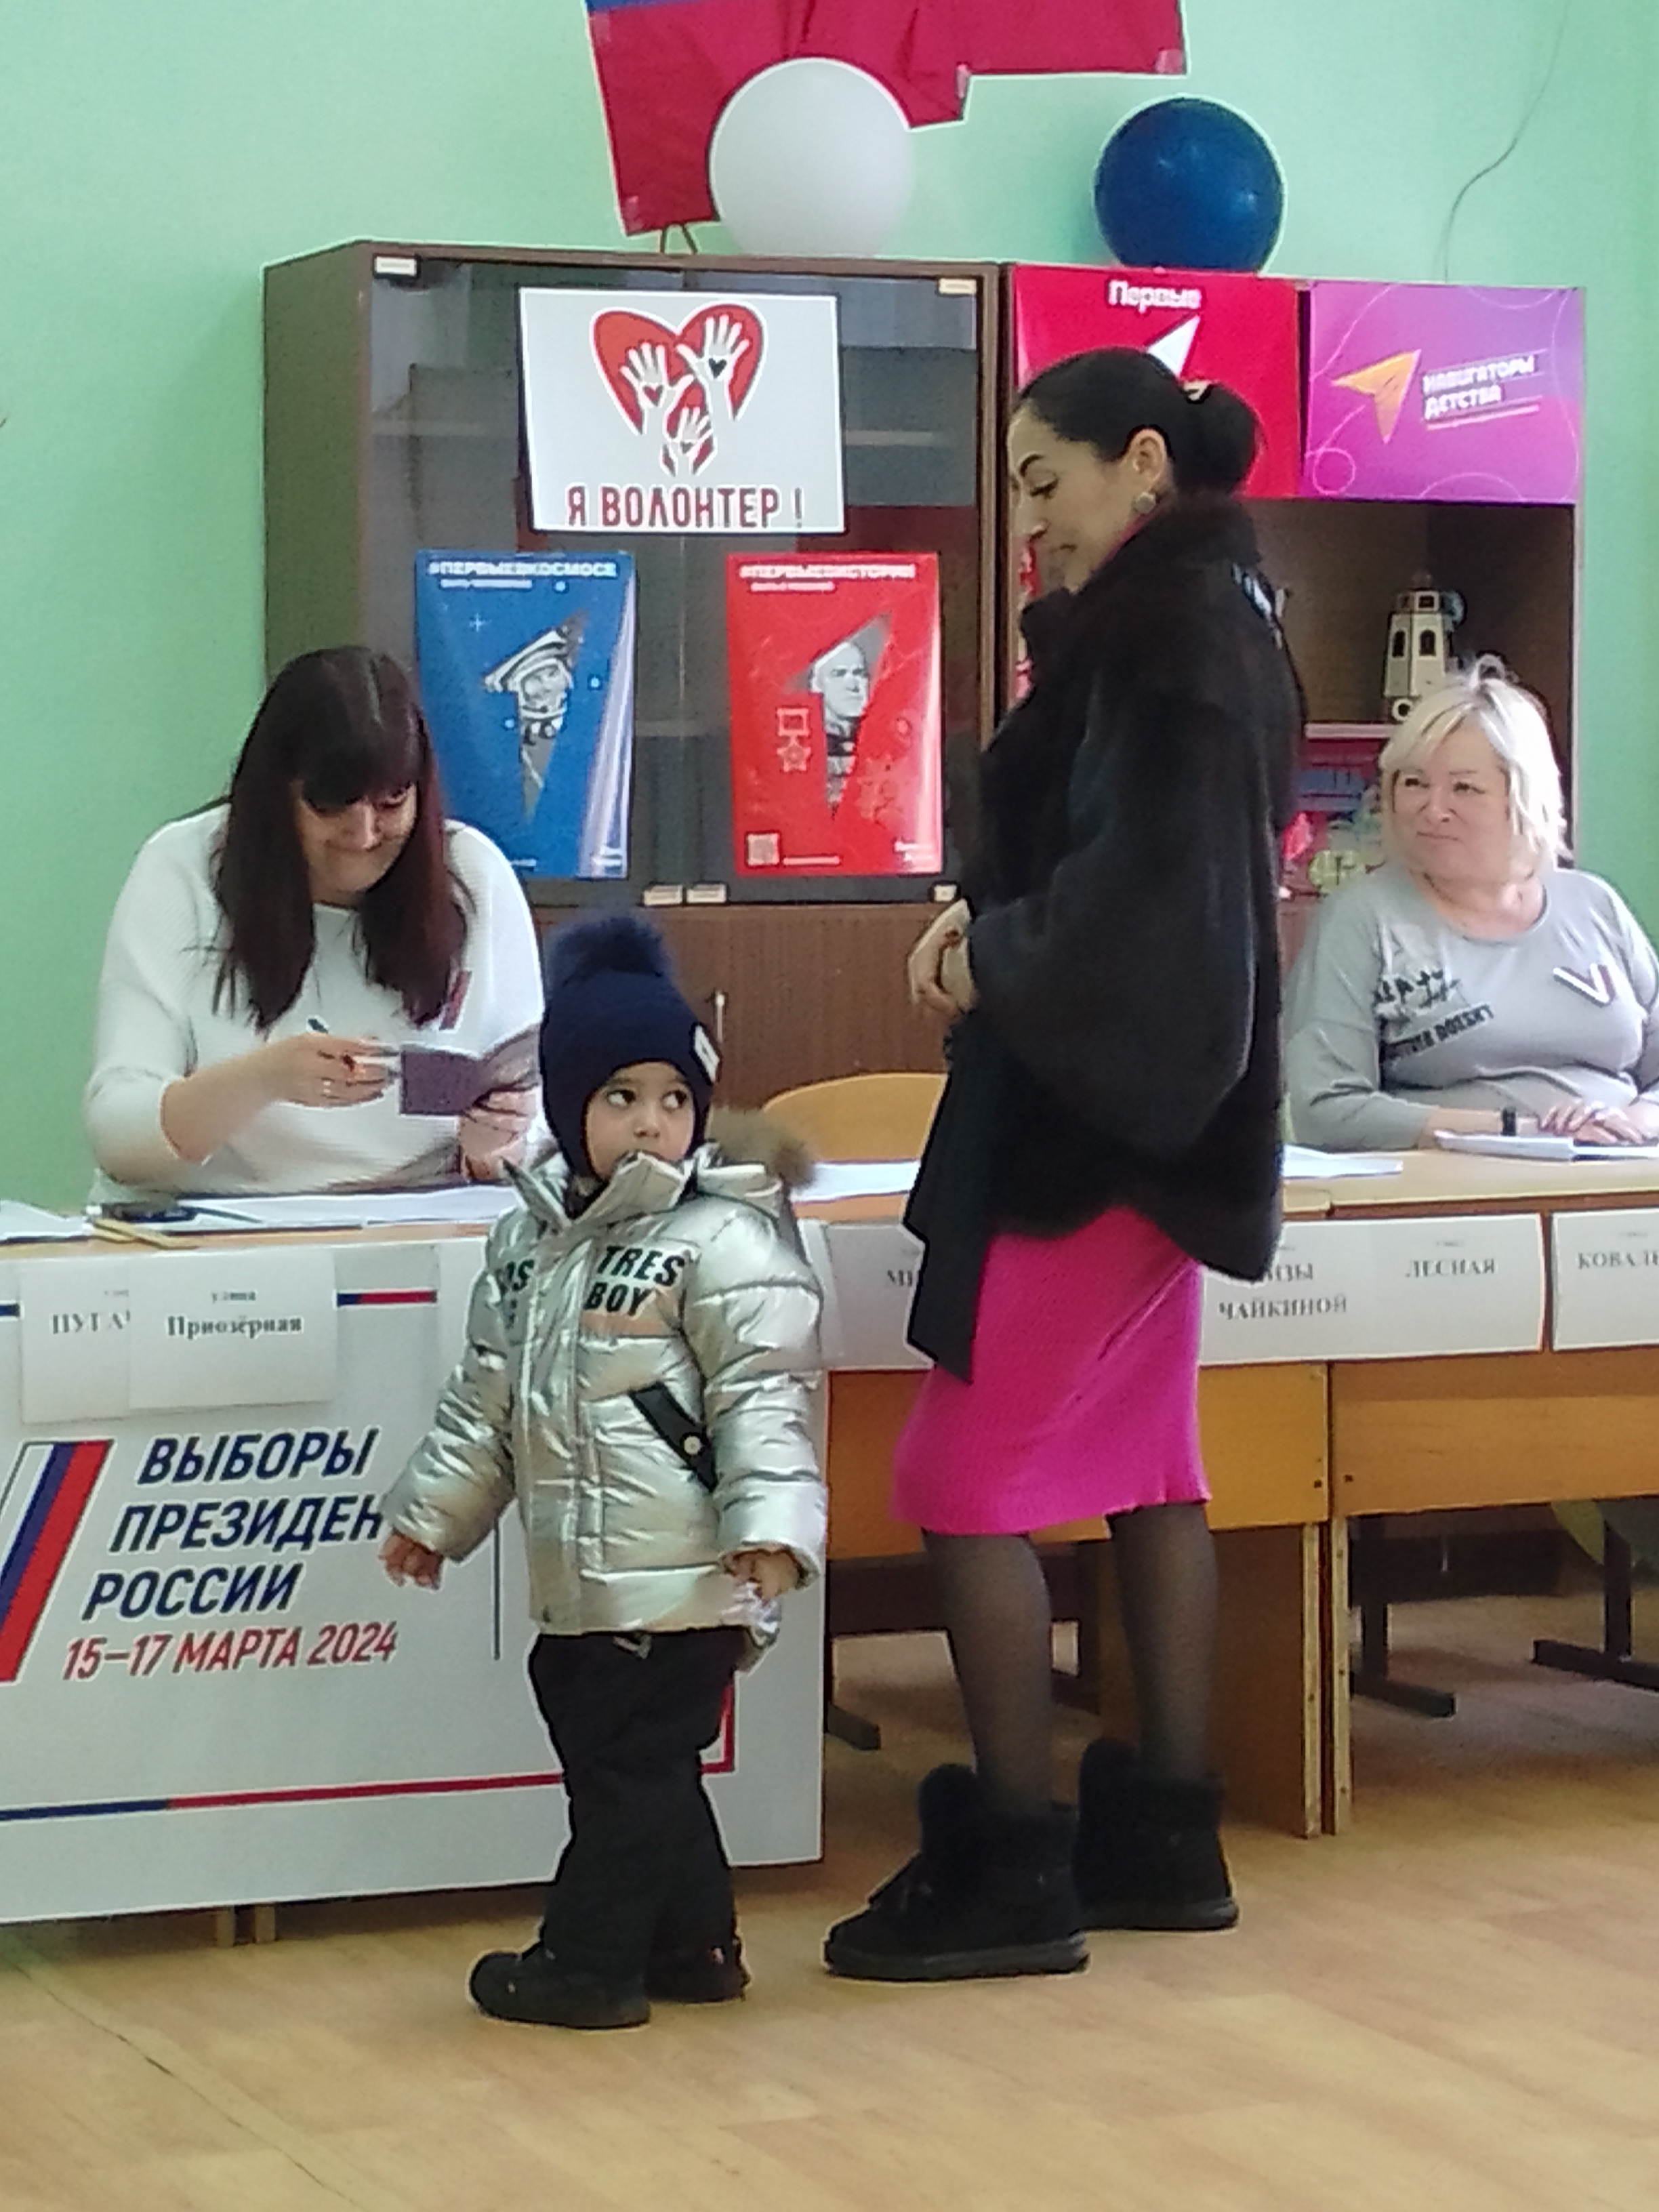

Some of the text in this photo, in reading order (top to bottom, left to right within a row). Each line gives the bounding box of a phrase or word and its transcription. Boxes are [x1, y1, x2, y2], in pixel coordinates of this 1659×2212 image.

[1108, 280, 1202, 314] Первые
[1425, 385, 1502, 420] ДЕТСТВА
[567, 486, 586, 527] Я
[601, 486, 779, 528] ВОЛОНТЕР
[597, 1246, 685, 1286] TRES
[1406, 1258, 1498, 1279] ЛЕСНАЯ
[583, 1282, 651, 1316] BOY
[1218, 1292, 1347, 1321] ЧАЙКИНОЙ
[166, 1313, 303, 1341] Приозёрная
[137, 1428, 380, 1484] ВЫБОРЫ
[110, 1495, 383, 1552] ПРЕЗИДЕН
[81, 1563, 303, 1620] РОССИИ
[173, 1627, 301, 1674] МАРТА
[307, 1622, 398, 1666] 2024
